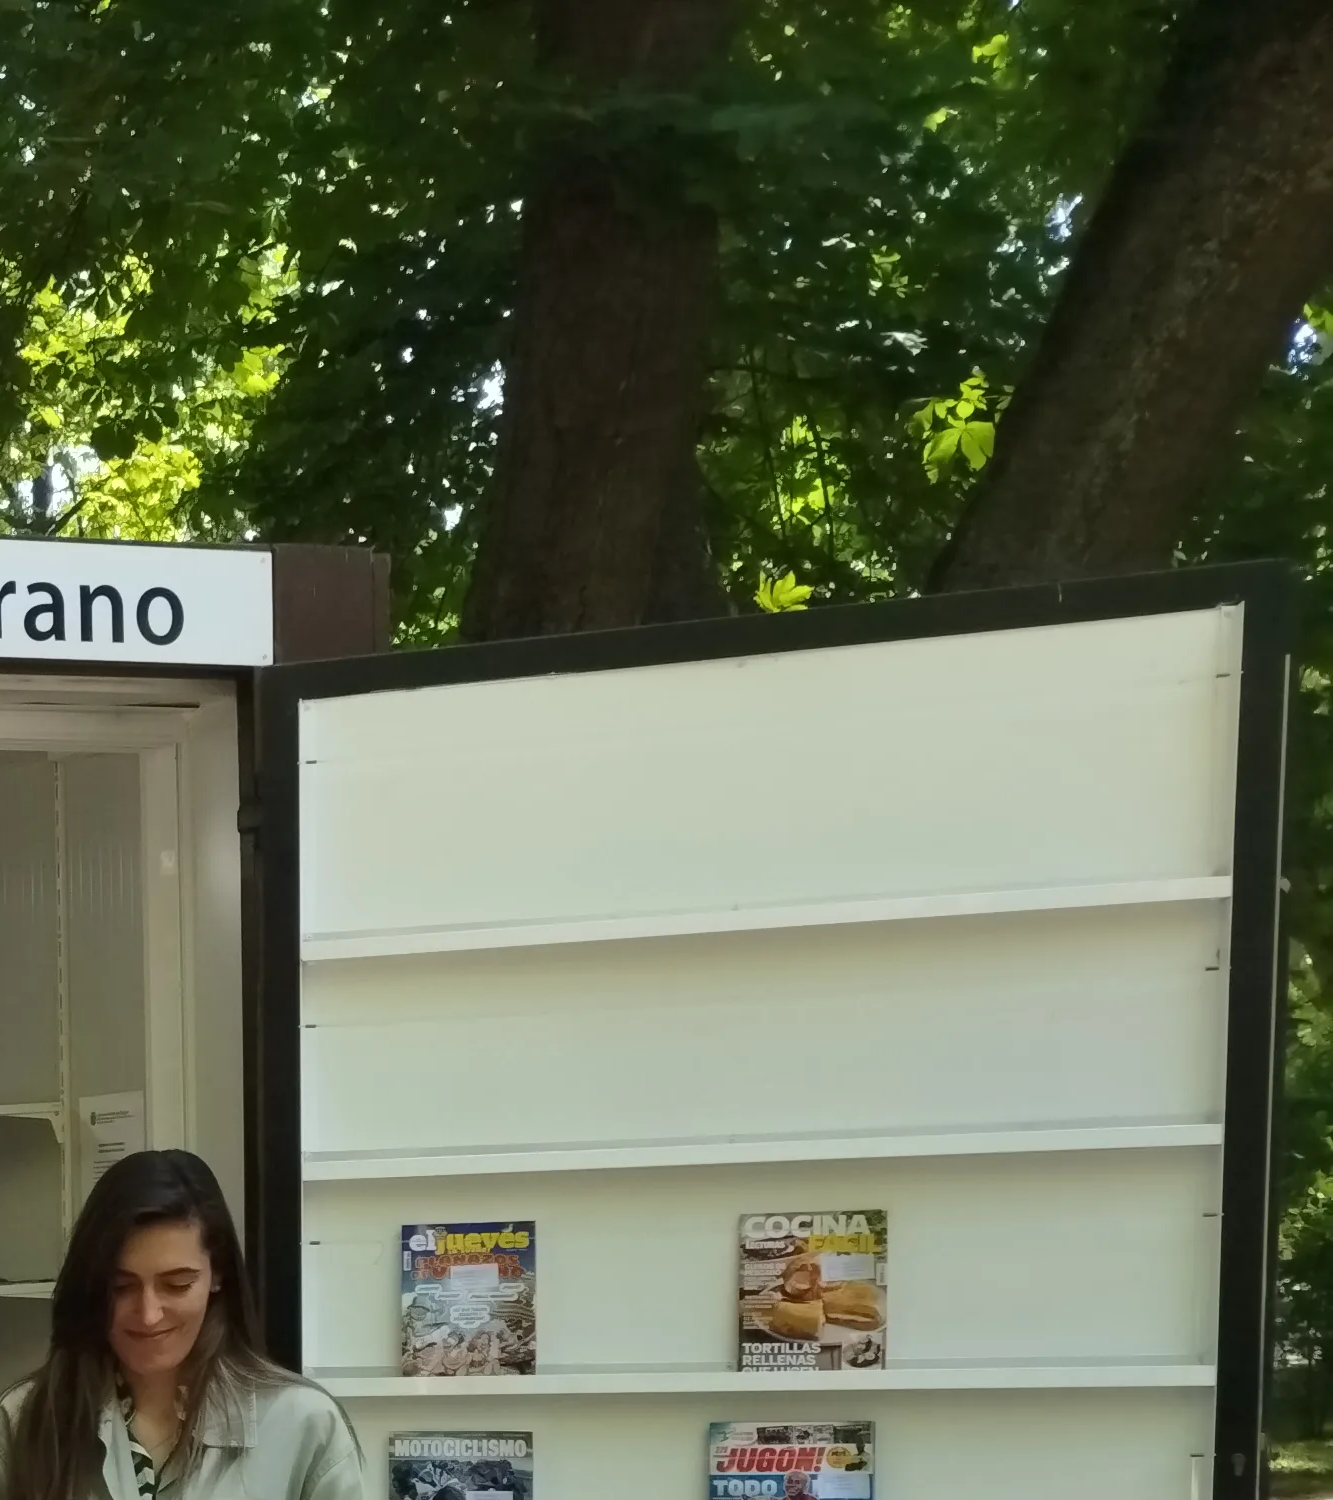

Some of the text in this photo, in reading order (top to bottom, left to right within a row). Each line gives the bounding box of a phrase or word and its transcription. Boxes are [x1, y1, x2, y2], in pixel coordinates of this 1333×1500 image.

[744, 1214, 871, 1239] COCINA
[409, 1229, 437, 1251] el
[742, 1342, 821, 1354] TORTILLAS
[742, 1355, 816, 1366] RELLENAS
[394, 1439, 527, 1457] MOTOCICLISMO
[713, 1479, 778, 1496] TODO
